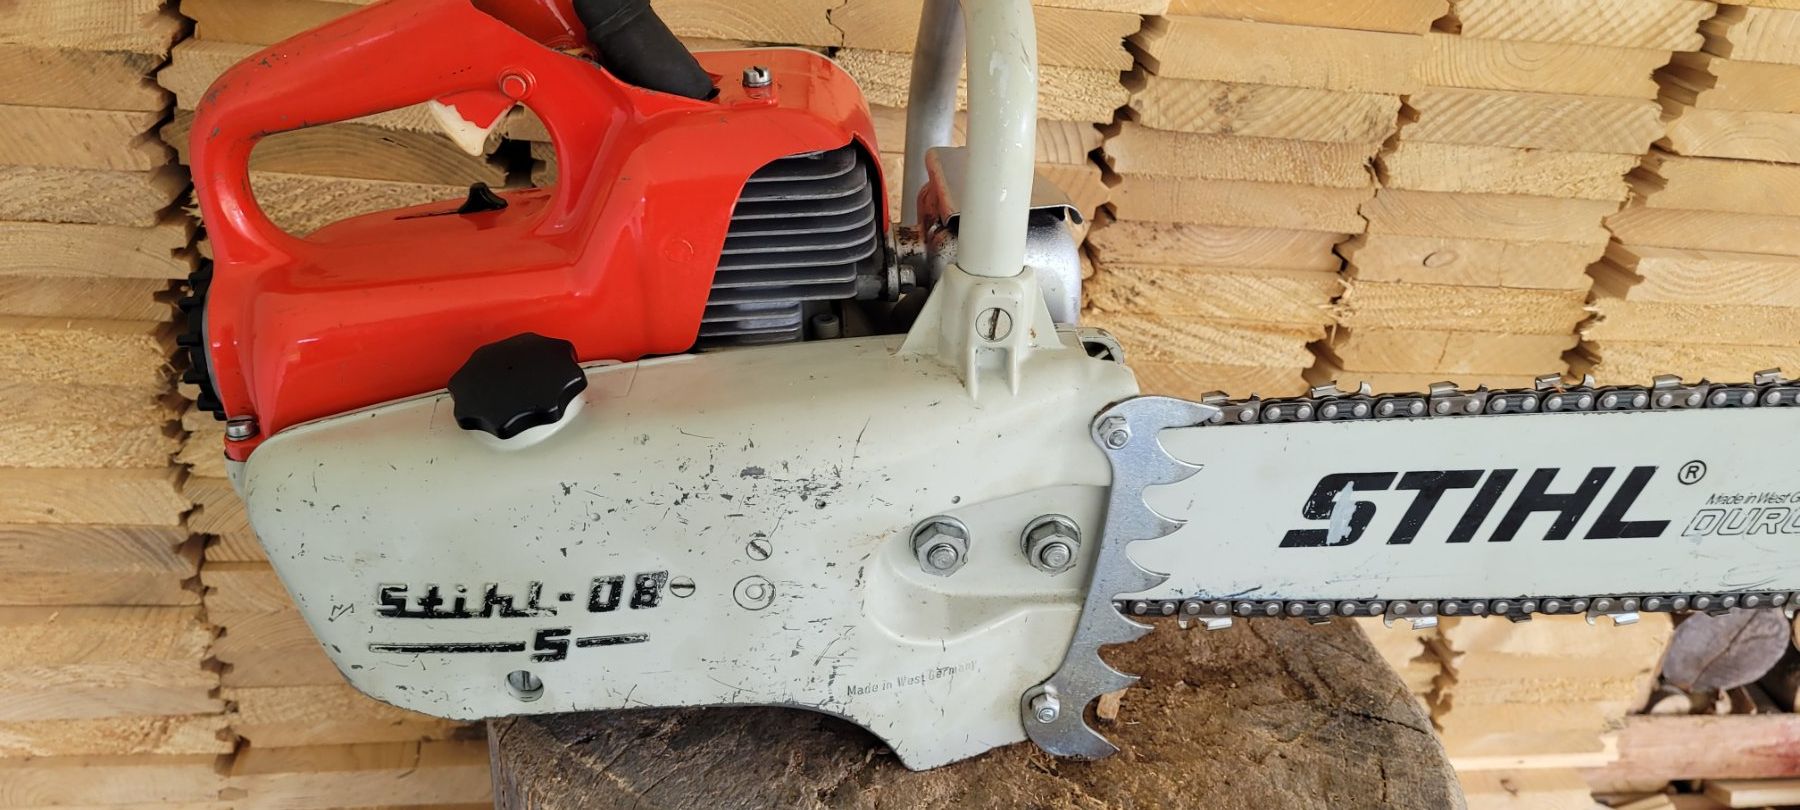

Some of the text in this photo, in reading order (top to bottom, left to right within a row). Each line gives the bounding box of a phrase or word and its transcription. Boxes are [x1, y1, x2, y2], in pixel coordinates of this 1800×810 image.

[1279, 466, 1672, 548] STIHL
[1705, 492, 1744, 505] Made
[1743, 492, 1758, 504] in
[1757, 492, 1791, 504] West
[847, 683, 879, 697] Made
[882, 680, 893, 691] in
[897, 672, 926, 687] West
